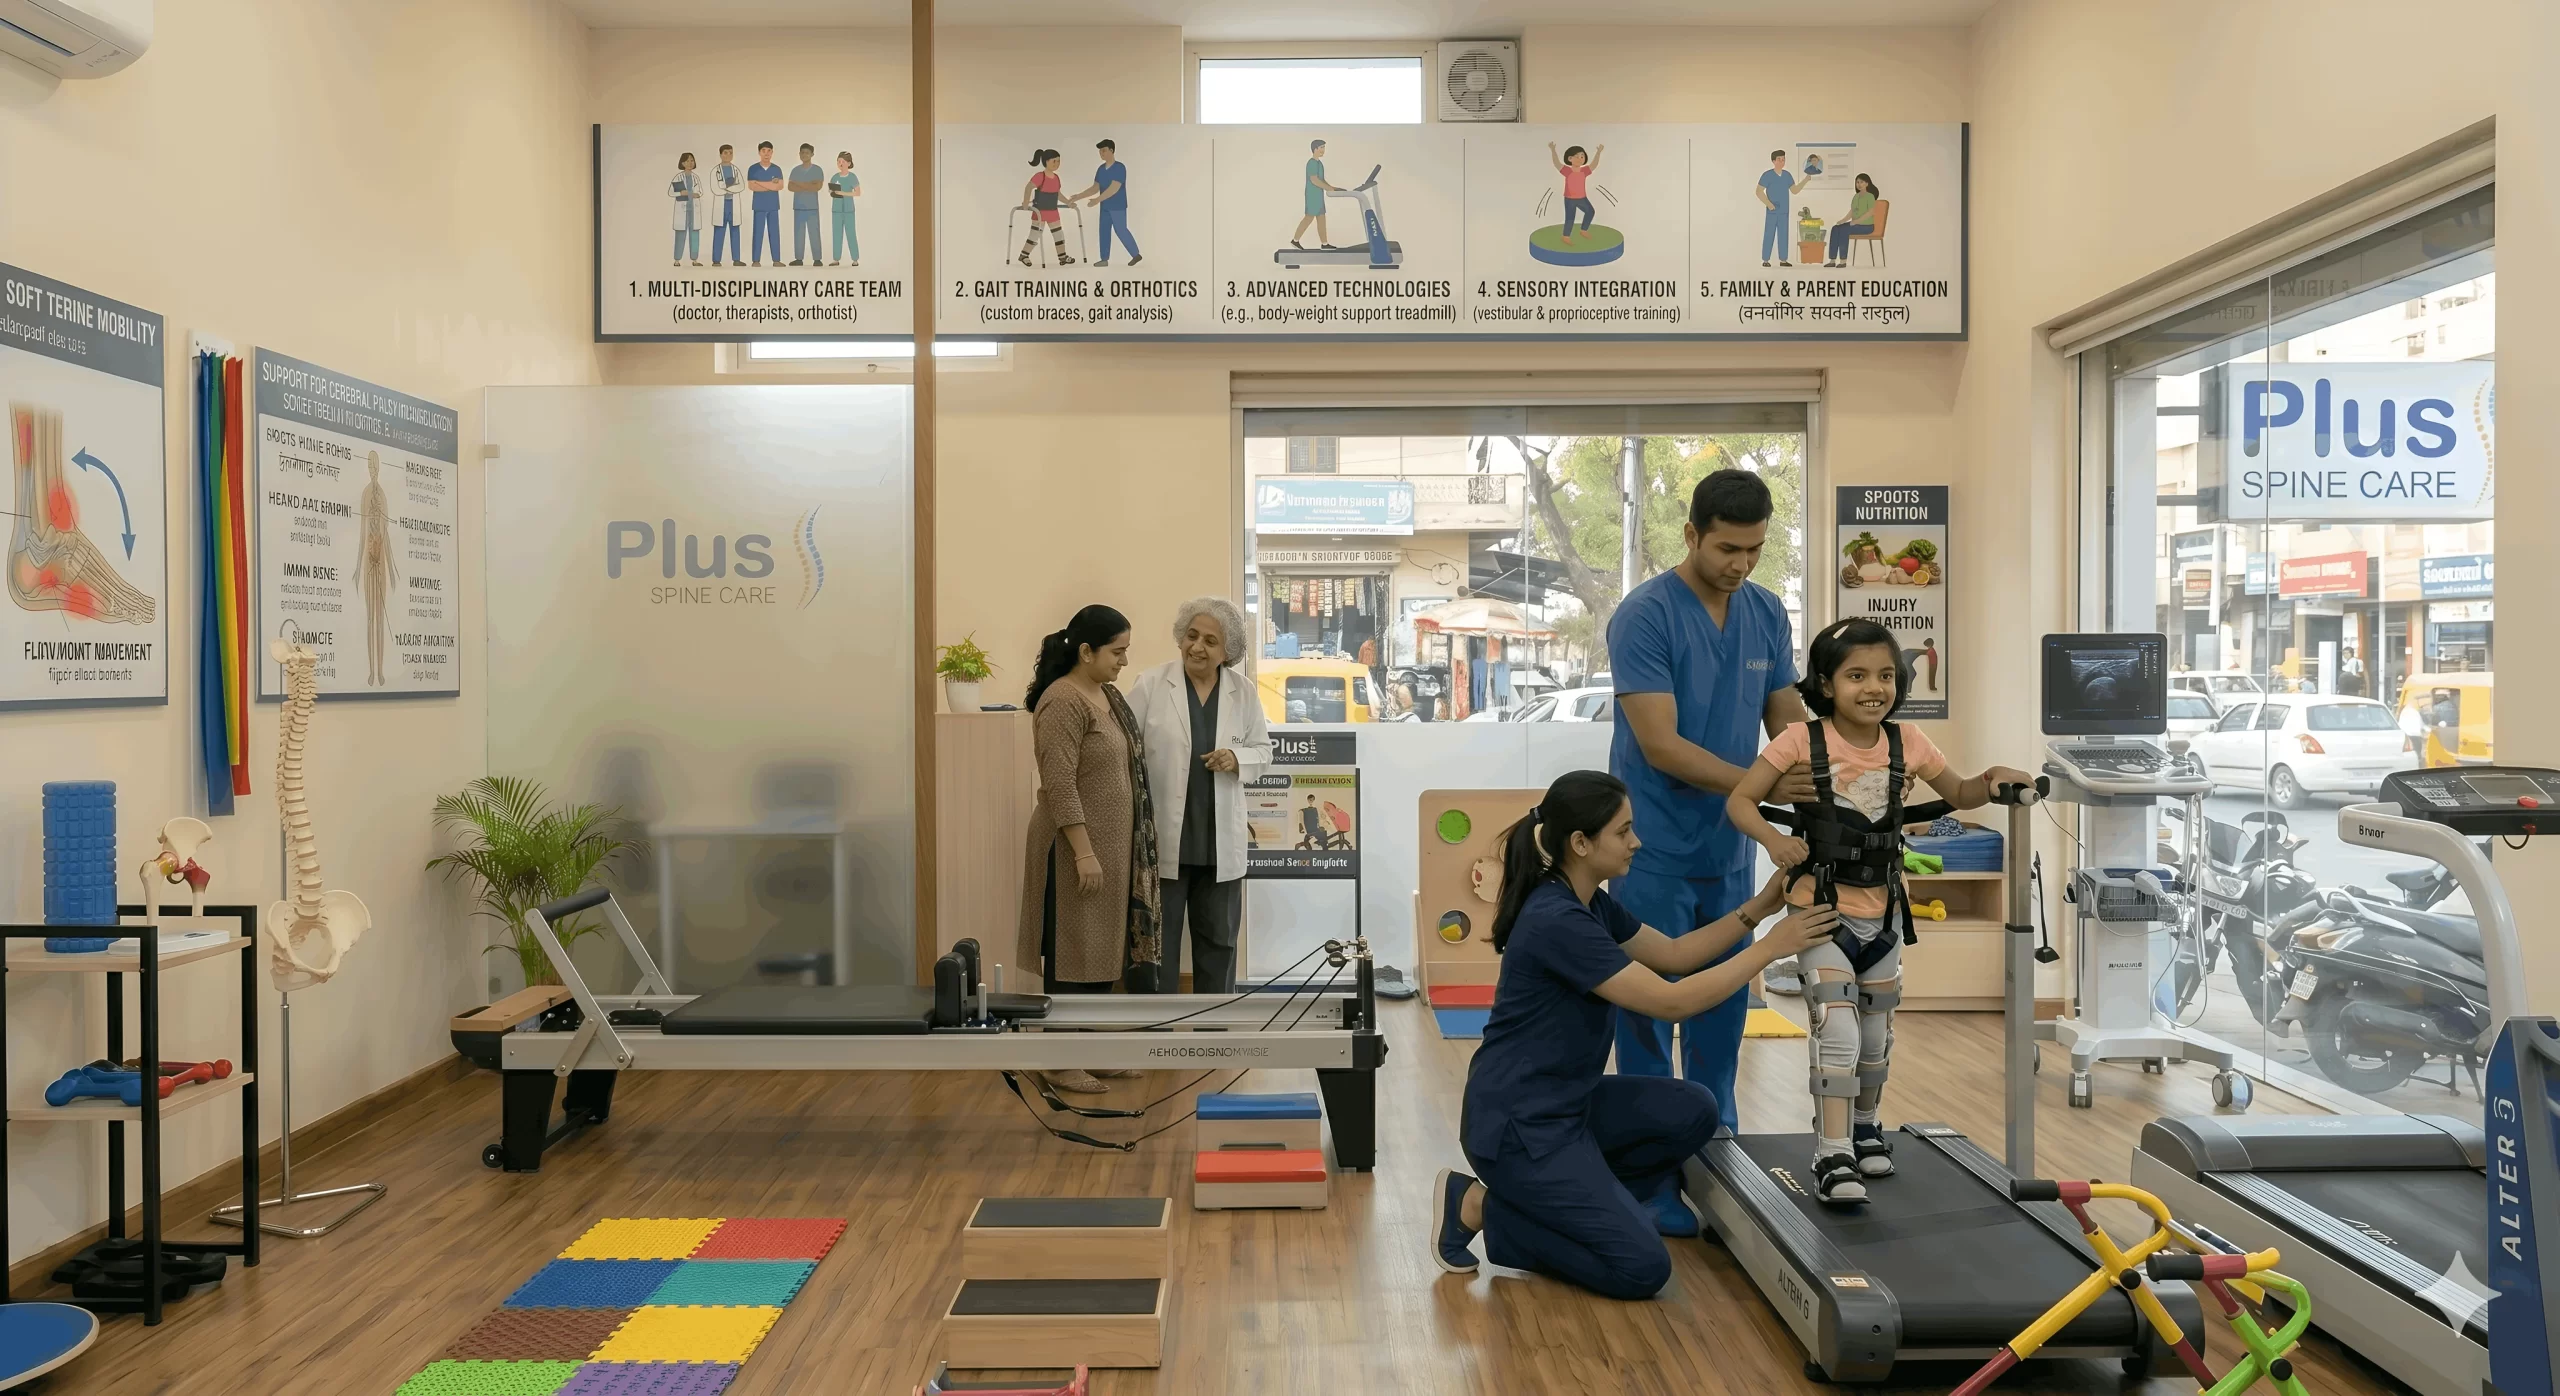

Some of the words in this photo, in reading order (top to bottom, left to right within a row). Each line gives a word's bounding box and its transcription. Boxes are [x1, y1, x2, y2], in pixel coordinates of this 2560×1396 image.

[629, 281, 642, 298] 1.
[648, 281, 809, 298] MULTI-DISCIPLINARY
[814, 281, 854, 298] CARE
[859, 281, 901, 298] TEAM
[955, 280, 969, 298] 2.
[974, 280, 1009, 298] GAIT
[1014, 280, 1087, 298] TRAINING
[1093, 280, 1105, 298] &
[1110, 280, 1198, 298] ORTHOTICS
[1227, 280, 1240, 298] 3.
[1246, 280, 1328, 298] ADVANCED
[1333, 280, 1451, 298] TECHNOLOGIES
[1477, 280, 1491, 298] 4.
[1497, 280, 1569, 298] SENSORY
[1574, 280, 1676, 298] INTEGRATION
[1701, 280, 1714, 298] 5.
[1719, 280, 1775, 298] FAMILY
[1780, 280, 1791, 298] &
[1797, 280, 1856, 298] PARENT
[1861, 280, 1948, 298] EDUCATION
[6, 279, 43, 312] SOFT
[46, 291, 94, 328] TERINE
[97, 307, 156, 346] MOBILITY
[673, 304, 722, 324] (doctor,
[726, 304, 793, 324] therapists,
[798, 304, 857, 324] orthotist)
[980, 305, 1033, 324] (custom
[1037, 305, 1084, 324] braces,
[1088, 305, 1112, 324] gait
[1116, 305, 1173, 324] analysis)
[1221, 305, 1254, 324] (e.g.,
[1259, 305, 1338, 324] body-weight
[1341, 305, 1391, 324] support
[1395, 305, 1456, 324] treadmill)
[1473, 305, 1533, 324] (vestibular
[1537, 305, 1545, 324] &
[1549, 305, 1630, 324] proprioceptive
[1633, 305, 1681, 324] training)
[262, 361, 308, 390] SUPPORT
[310, 374, 327, 397] FOR
[329, 381, 371, 410] CEREBRAL
[2243, 378, 2457, 458] Plus
[2242, 471, 2347, 499] SPINE
[2359, 471, 2457, 499] CARE
[1864, 490, 1919, 504] SPOOTS
[1855, 507, 1928, 520] NUTRITION
[607, 518, 775, 579] Plus
[651, 587, 712, 604] SPINE
[719, 587, 776, 604] CARE
[1868, 598, 1917, 612] INJURY
[2497, 1137, 2524, 1262] ALTER
